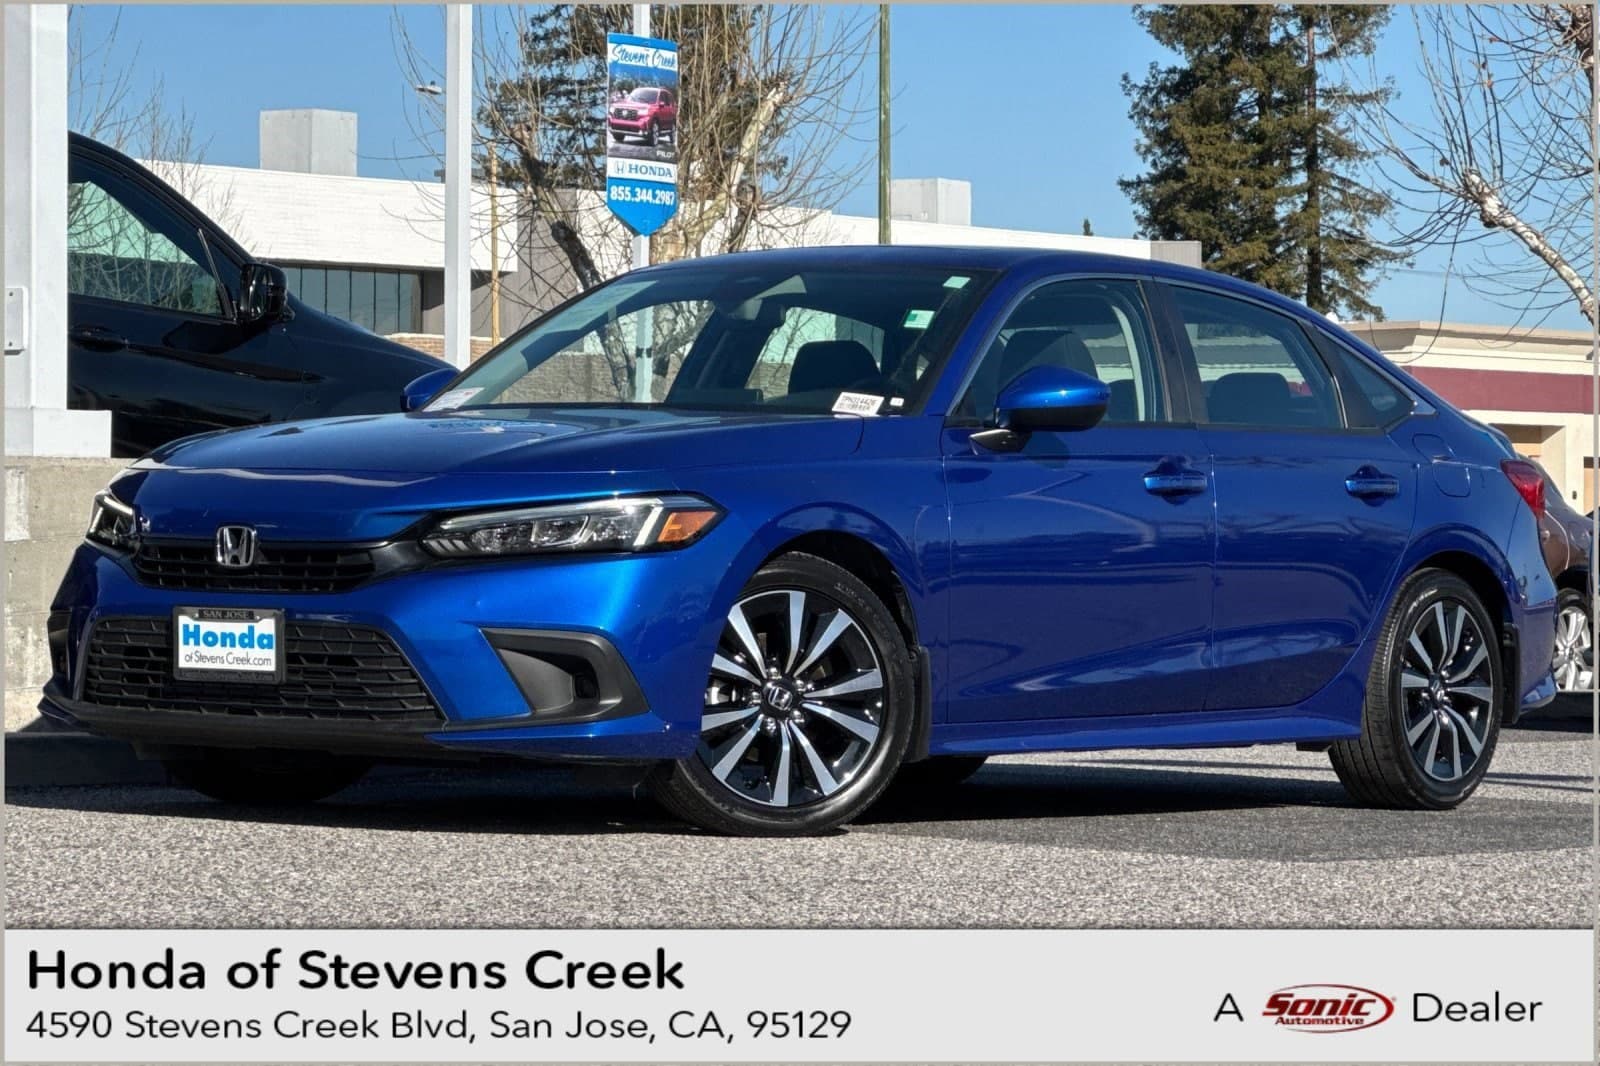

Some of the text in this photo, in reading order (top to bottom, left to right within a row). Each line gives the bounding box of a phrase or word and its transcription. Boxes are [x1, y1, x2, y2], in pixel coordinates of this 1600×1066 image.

[612, 44, 676, 68] Stevens Creek
[628, 163, 673, 178] HONDA
[203, 609, 250, 619] SAN JOSE
[182, 624, 274, 649] Honda
[184, 652, 193, 663] of
[194, 650, 225, 664] Stevens
